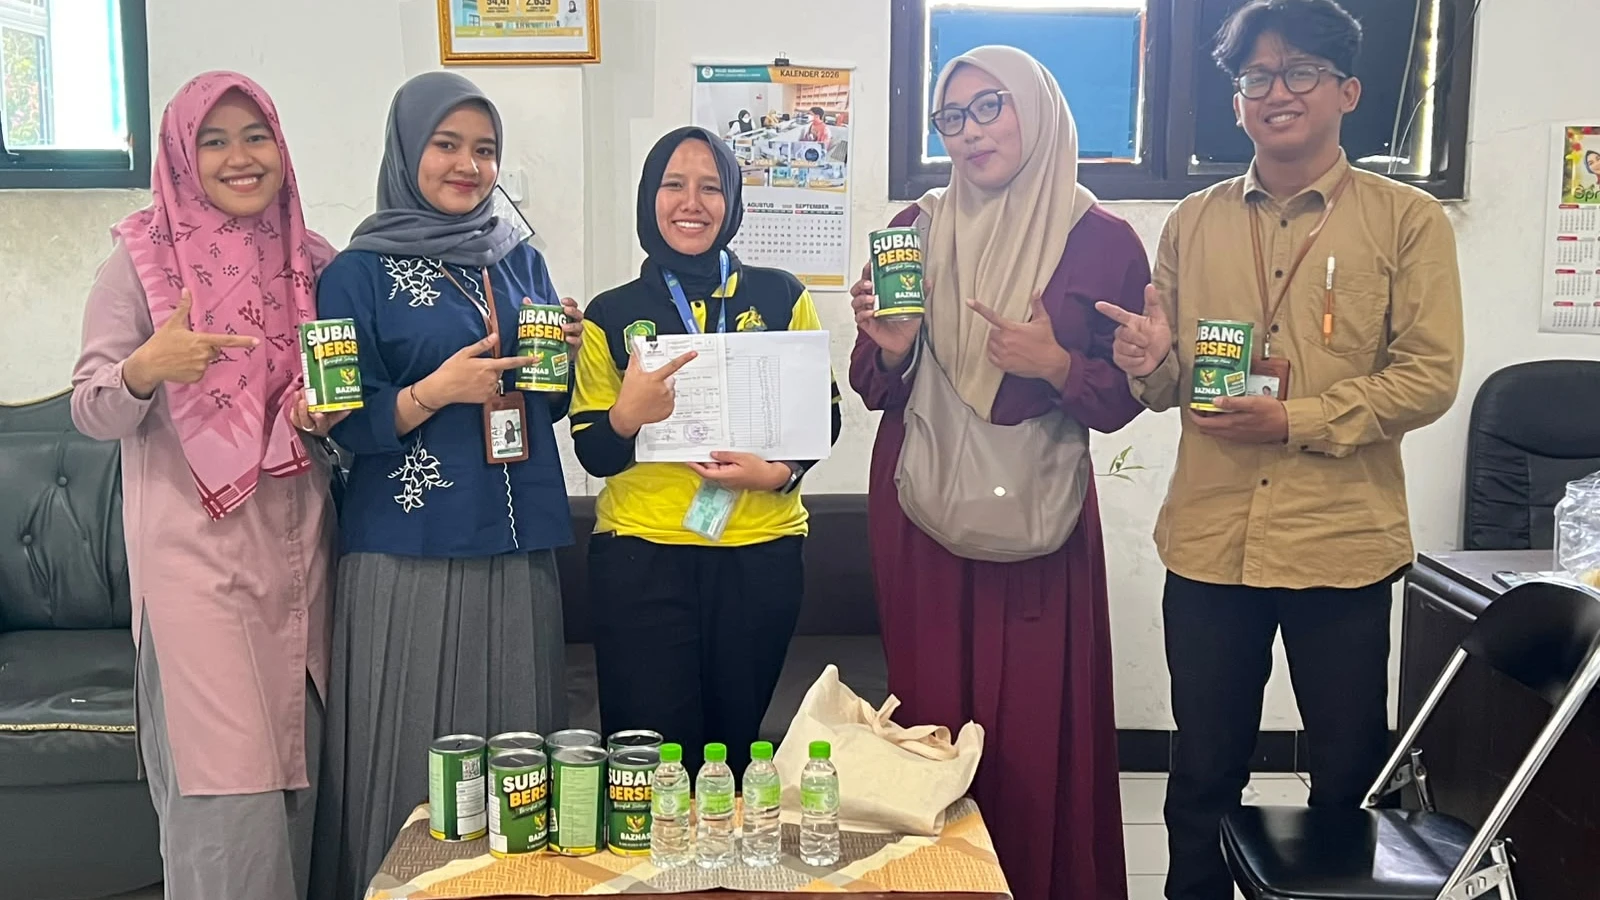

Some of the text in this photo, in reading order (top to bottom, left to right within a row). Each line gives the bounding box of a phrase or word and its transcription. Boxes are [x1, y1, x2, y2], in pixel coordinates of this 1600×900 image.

[780, 69, 840, 79] KALENDER 2026
[873, 234, 920, 255] SUBAN
[878, 249, 921, 267] BERSE
[519, 309, 567, 326] UBANG
[306, 325, 357, 346] SUBA
[1196, 326, 1245, 345] BANG
[314, 340, 358, 360] BERSE
[1196, 341, 1242, 359] ERSERI
[335, 386, 360, 394] BAZNA
[503, 767, 546, 793] SUBA
[509, 783, 547, 808] BERS
[609, 786, 652, 801] BERSE
[620, 832, 651, 840] BAZNAS
